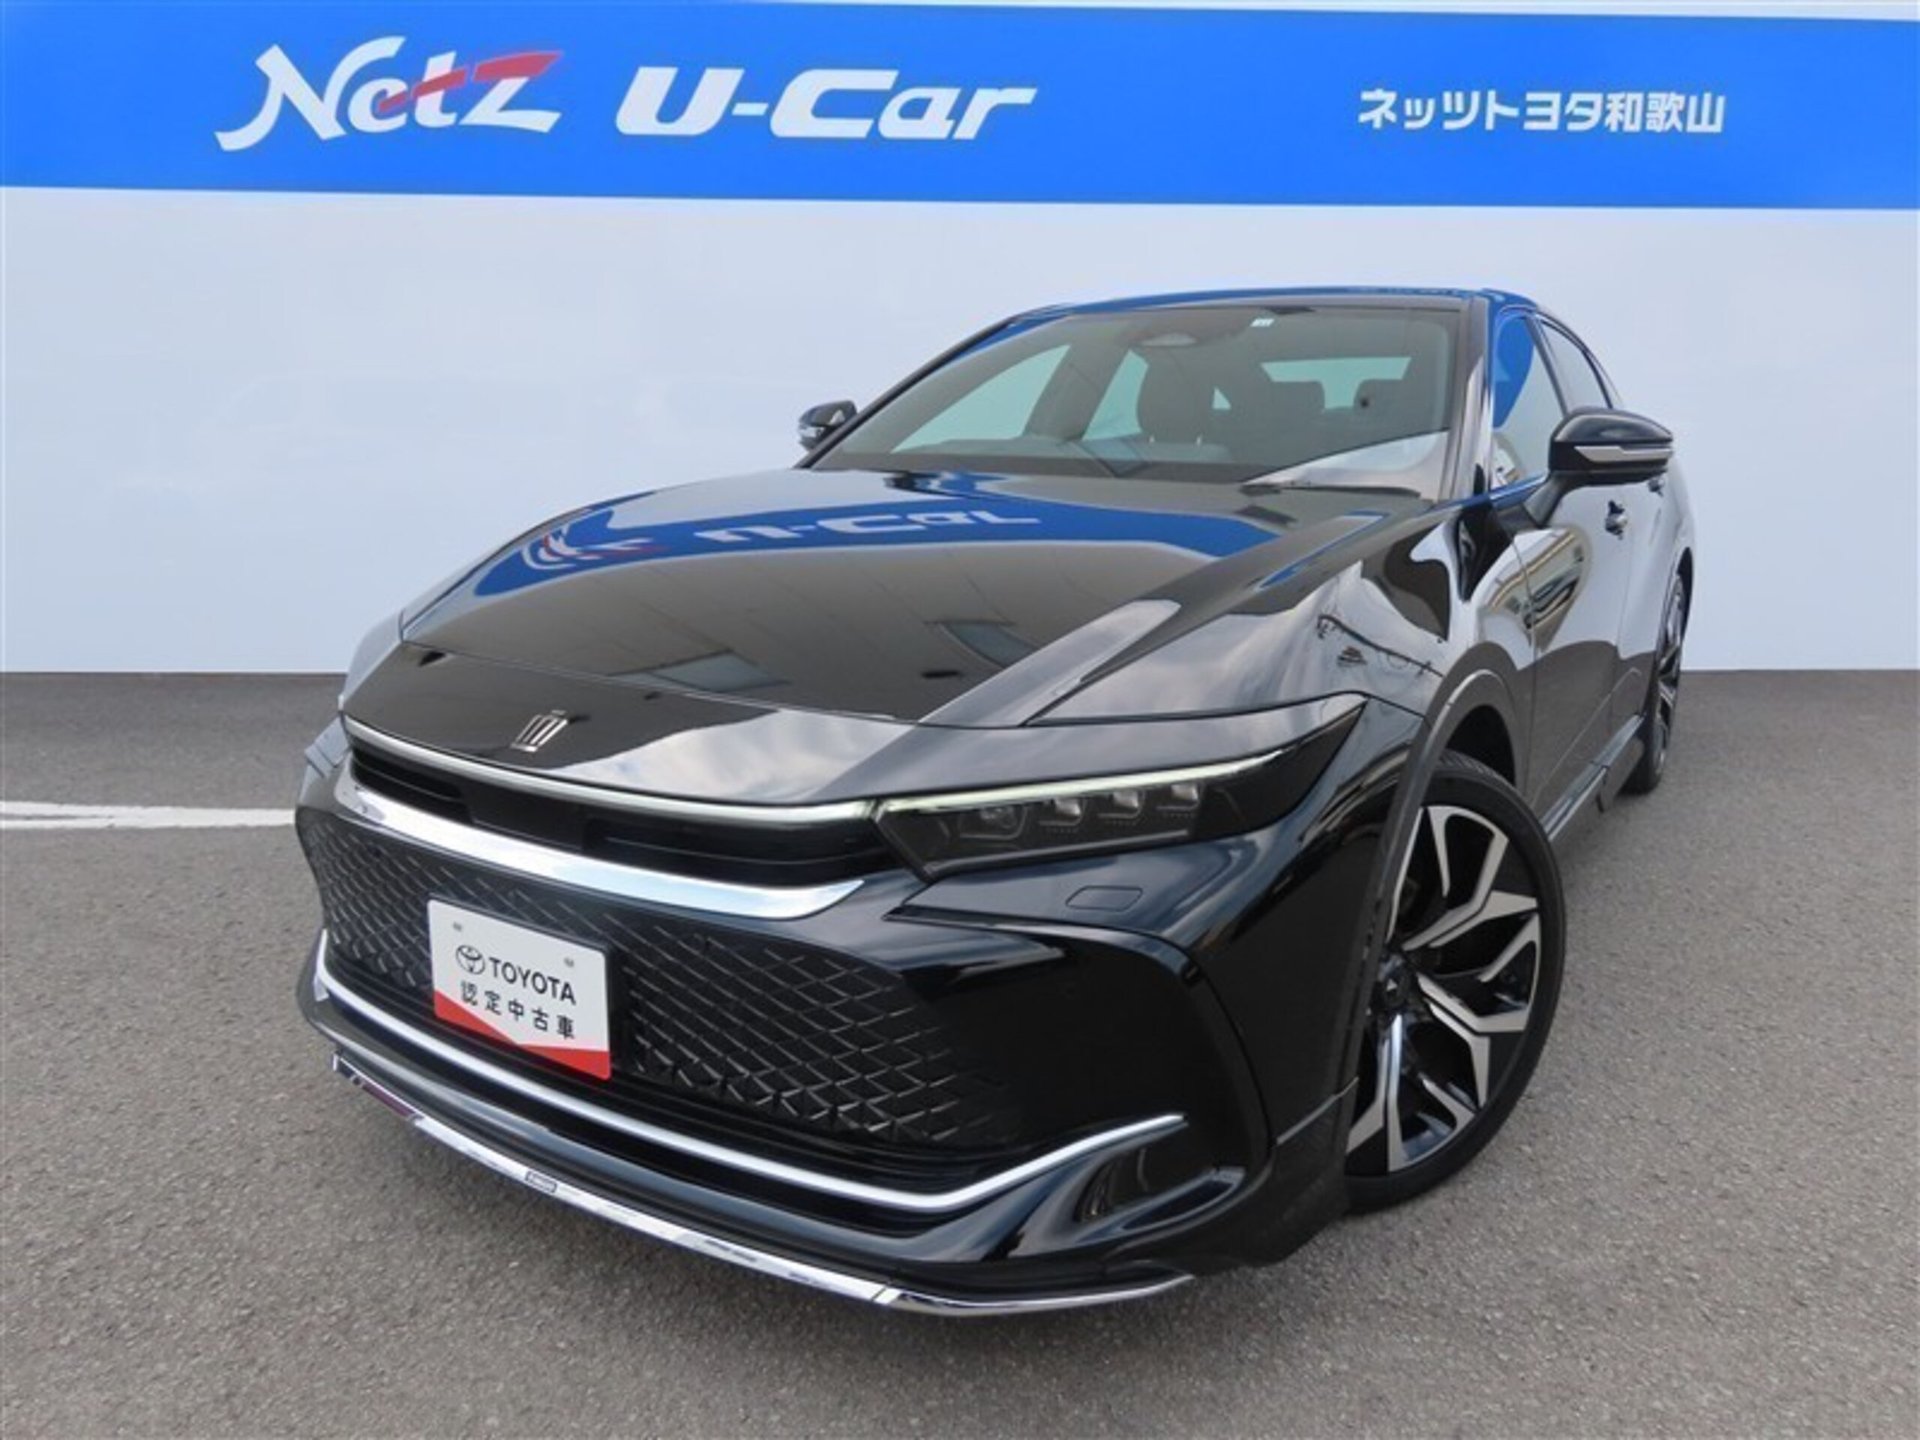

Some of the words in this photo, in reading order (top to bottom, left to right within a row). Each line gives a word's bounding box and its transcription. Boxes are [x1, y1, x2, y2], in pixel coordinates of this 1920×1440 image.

[215, 36, 562, 151] Netz
[615, 66, 1037, 140] U-Car
[1357, 88, 1726, 133] ネッツトヨタ和歌山
[489, 957, 577, 1005] TOYOTA
[460, 981, 576, 1040] 認定中古車
